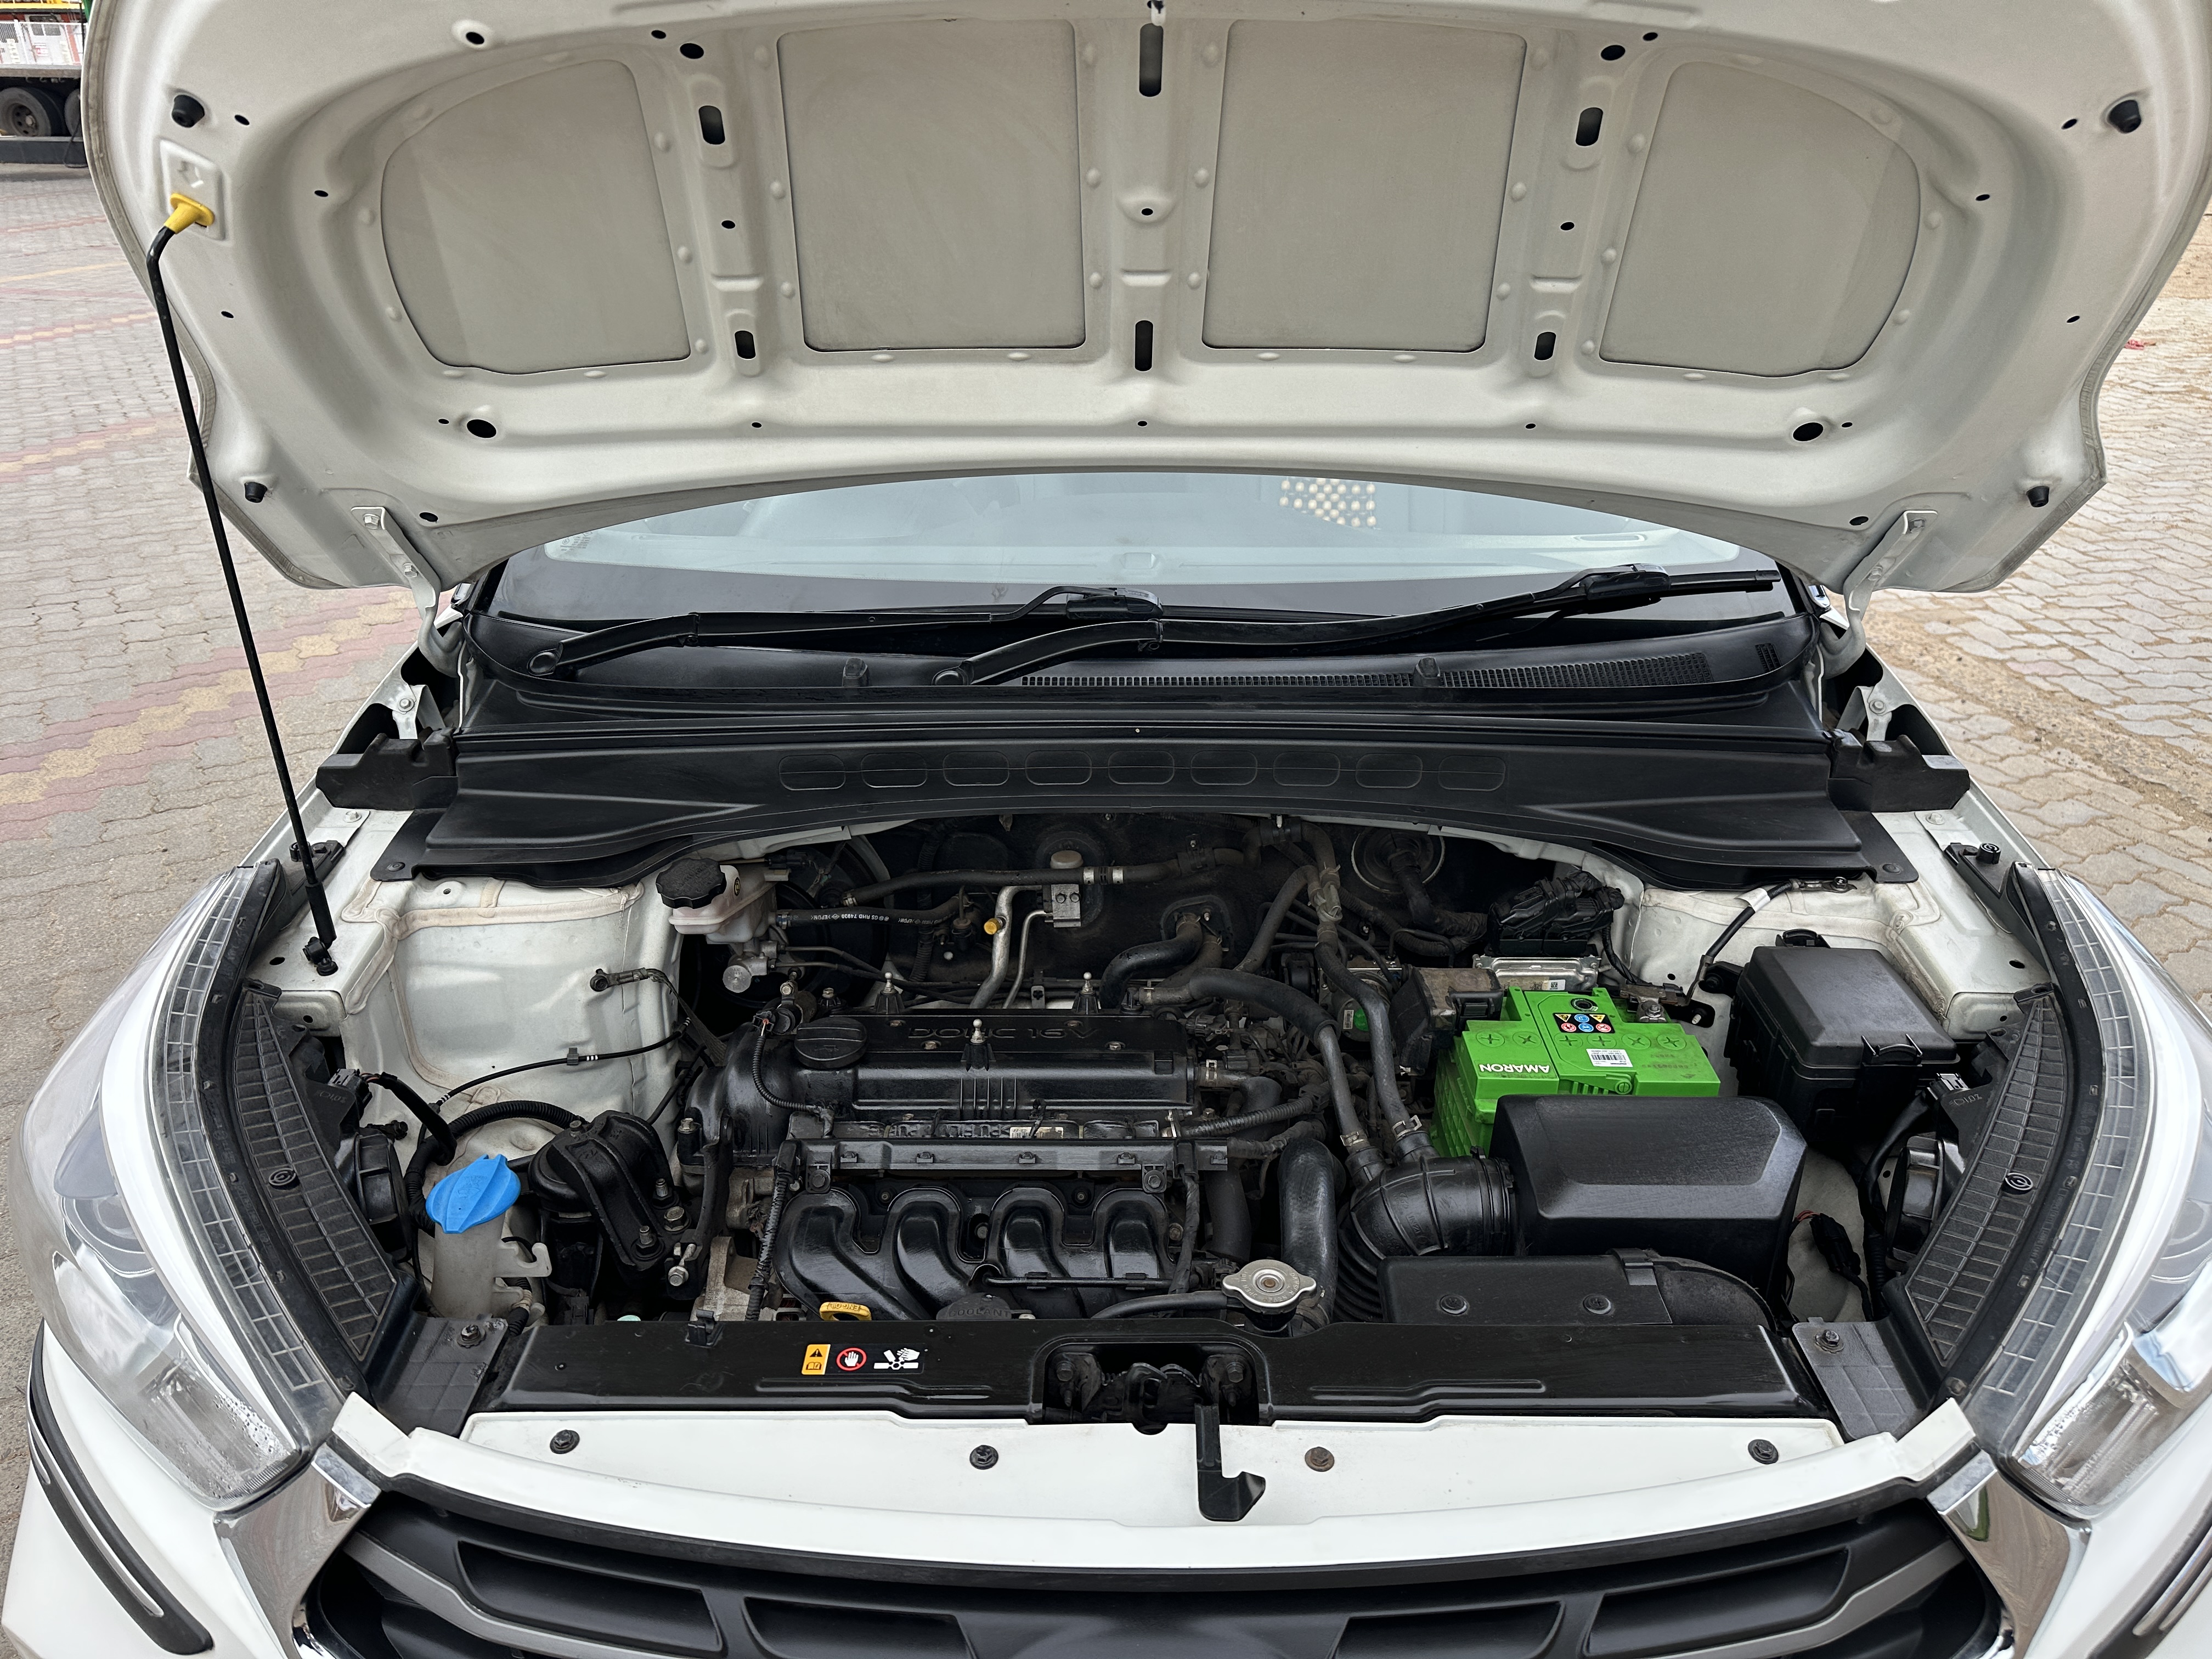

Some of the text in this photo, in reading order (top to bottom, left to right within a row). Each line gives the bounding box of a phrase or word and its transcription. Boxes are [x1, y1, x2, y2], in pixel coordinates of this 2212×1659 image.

[908, 1028, 1098, 1039] DOHC 16V
[1479, 1063, 1550, 1074] AMARON
[842, 1304, 860, 1312] ENG
[948, 1307, 1011, 1317] COOLANT
